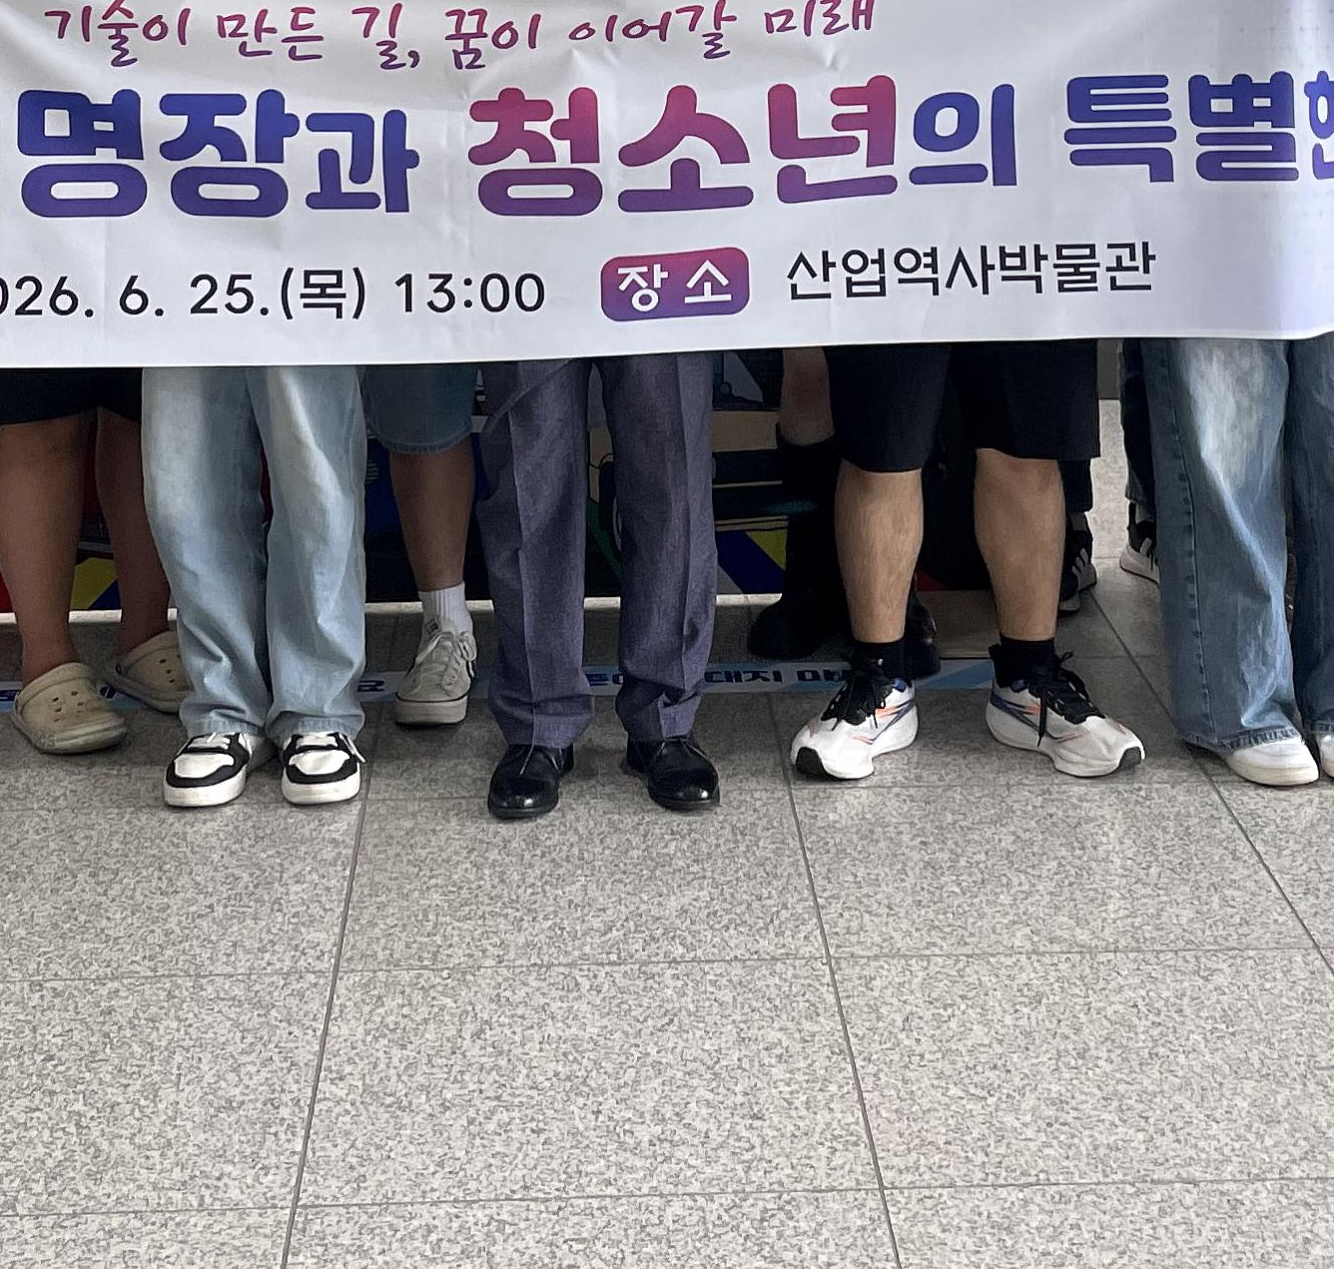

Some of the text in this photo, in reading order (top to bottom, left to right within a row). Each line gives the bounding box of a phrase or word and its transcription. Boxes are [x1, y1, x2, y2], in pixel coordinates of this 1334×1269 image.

[216, 6, 325, 62] 만든
[351, 2, 421, 71] 길,
[444, 7, 542, 70] 꿈이
[467, 74, 1018, 217] 청소년의
[118, 274, 165, 318] 6.
[394, 272, 546, 314] 13:00
[616, 240, 1157, 311] 장소 산업역사박물관
